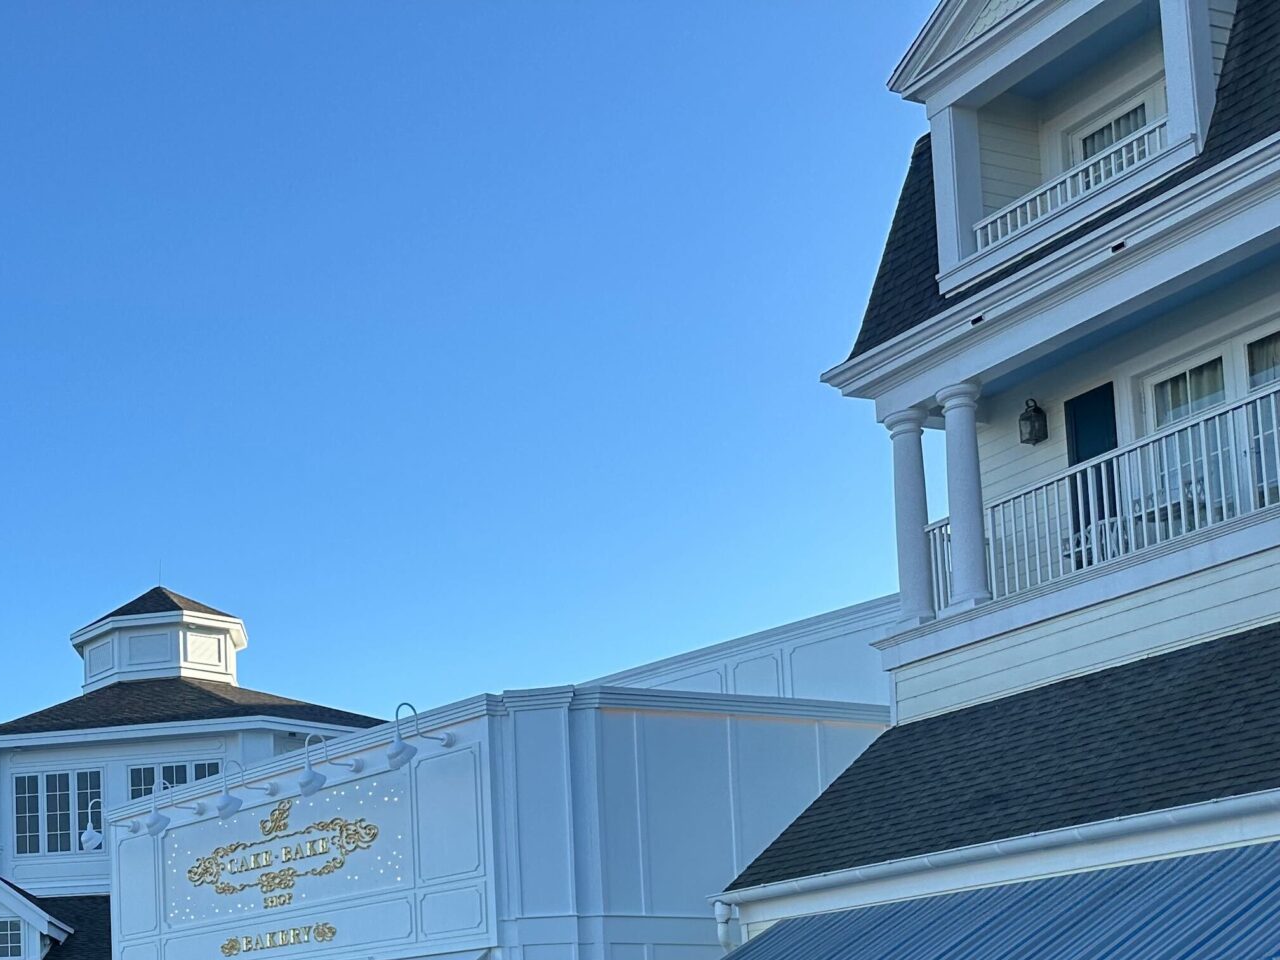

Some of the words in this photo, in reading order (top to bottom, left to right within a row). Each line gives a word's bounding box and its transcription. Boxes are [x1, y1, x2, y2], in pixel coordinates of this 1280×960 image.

[260, 800, 292, 836] The
[227, 850, 272, 874] CAKE
[282, 837, 330, 863] BAKE
[263, 893, 293, 909] SHOP
[242, 925, 313, 952] BAKERY
